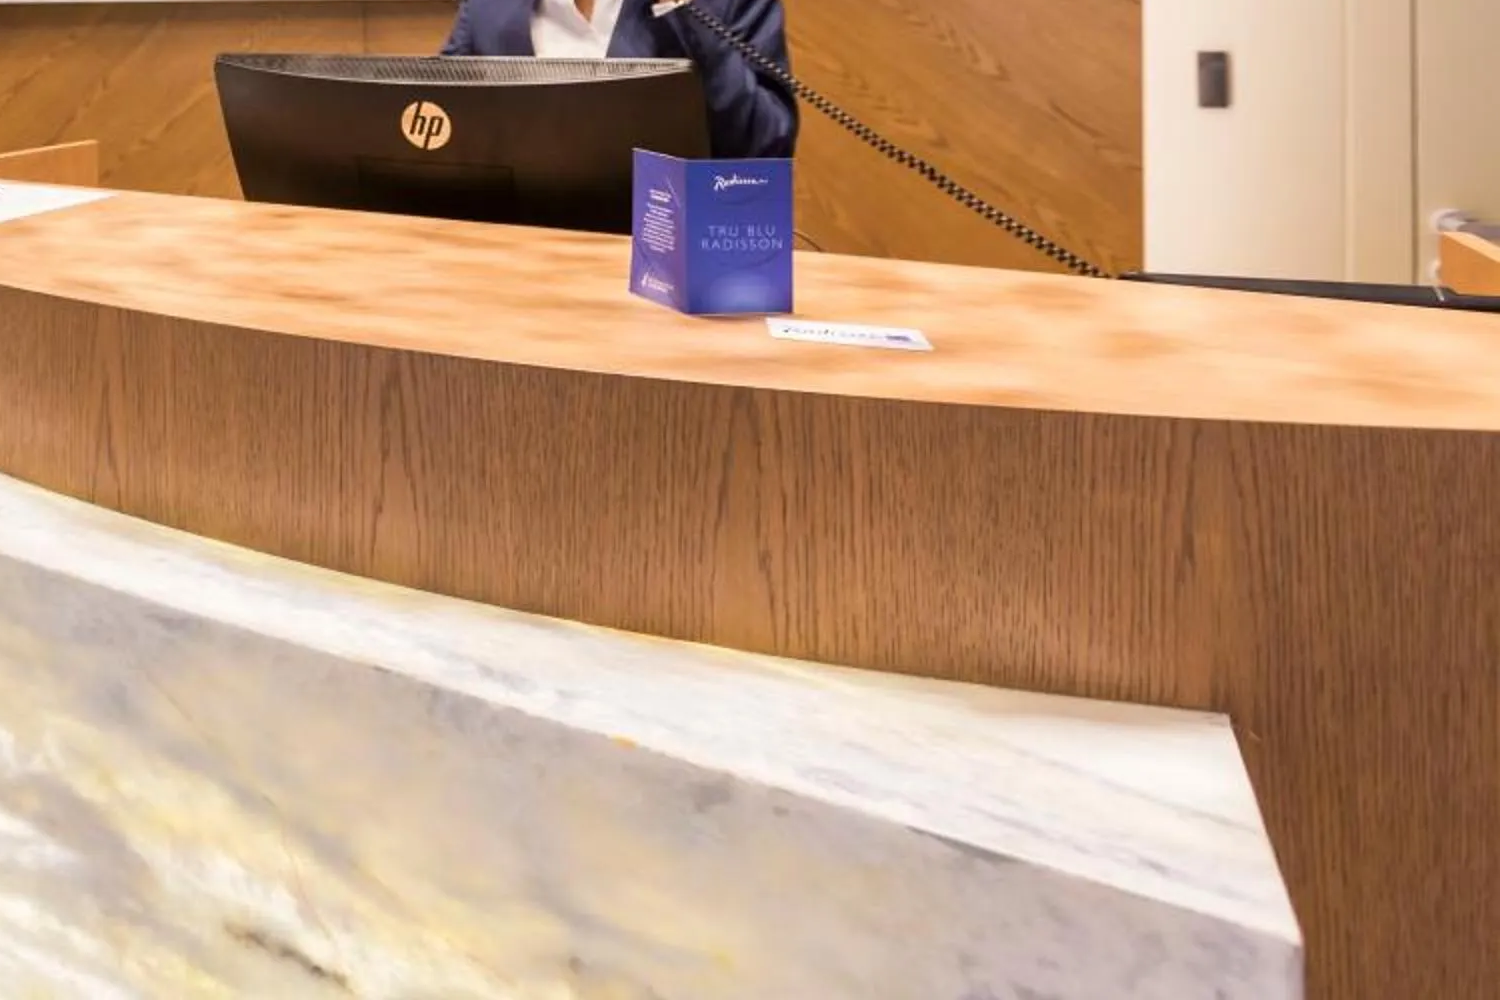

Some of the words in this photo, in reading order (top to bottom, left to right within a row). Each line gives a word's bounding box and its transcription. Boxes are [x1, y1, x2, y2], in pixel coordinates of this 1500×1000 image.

[409, 101, 444, 149] hp
[708, 225, 739, 237] TRU
[747, 224, 776, 237] BLU
[701, 238, 783, 250] RADISSON
